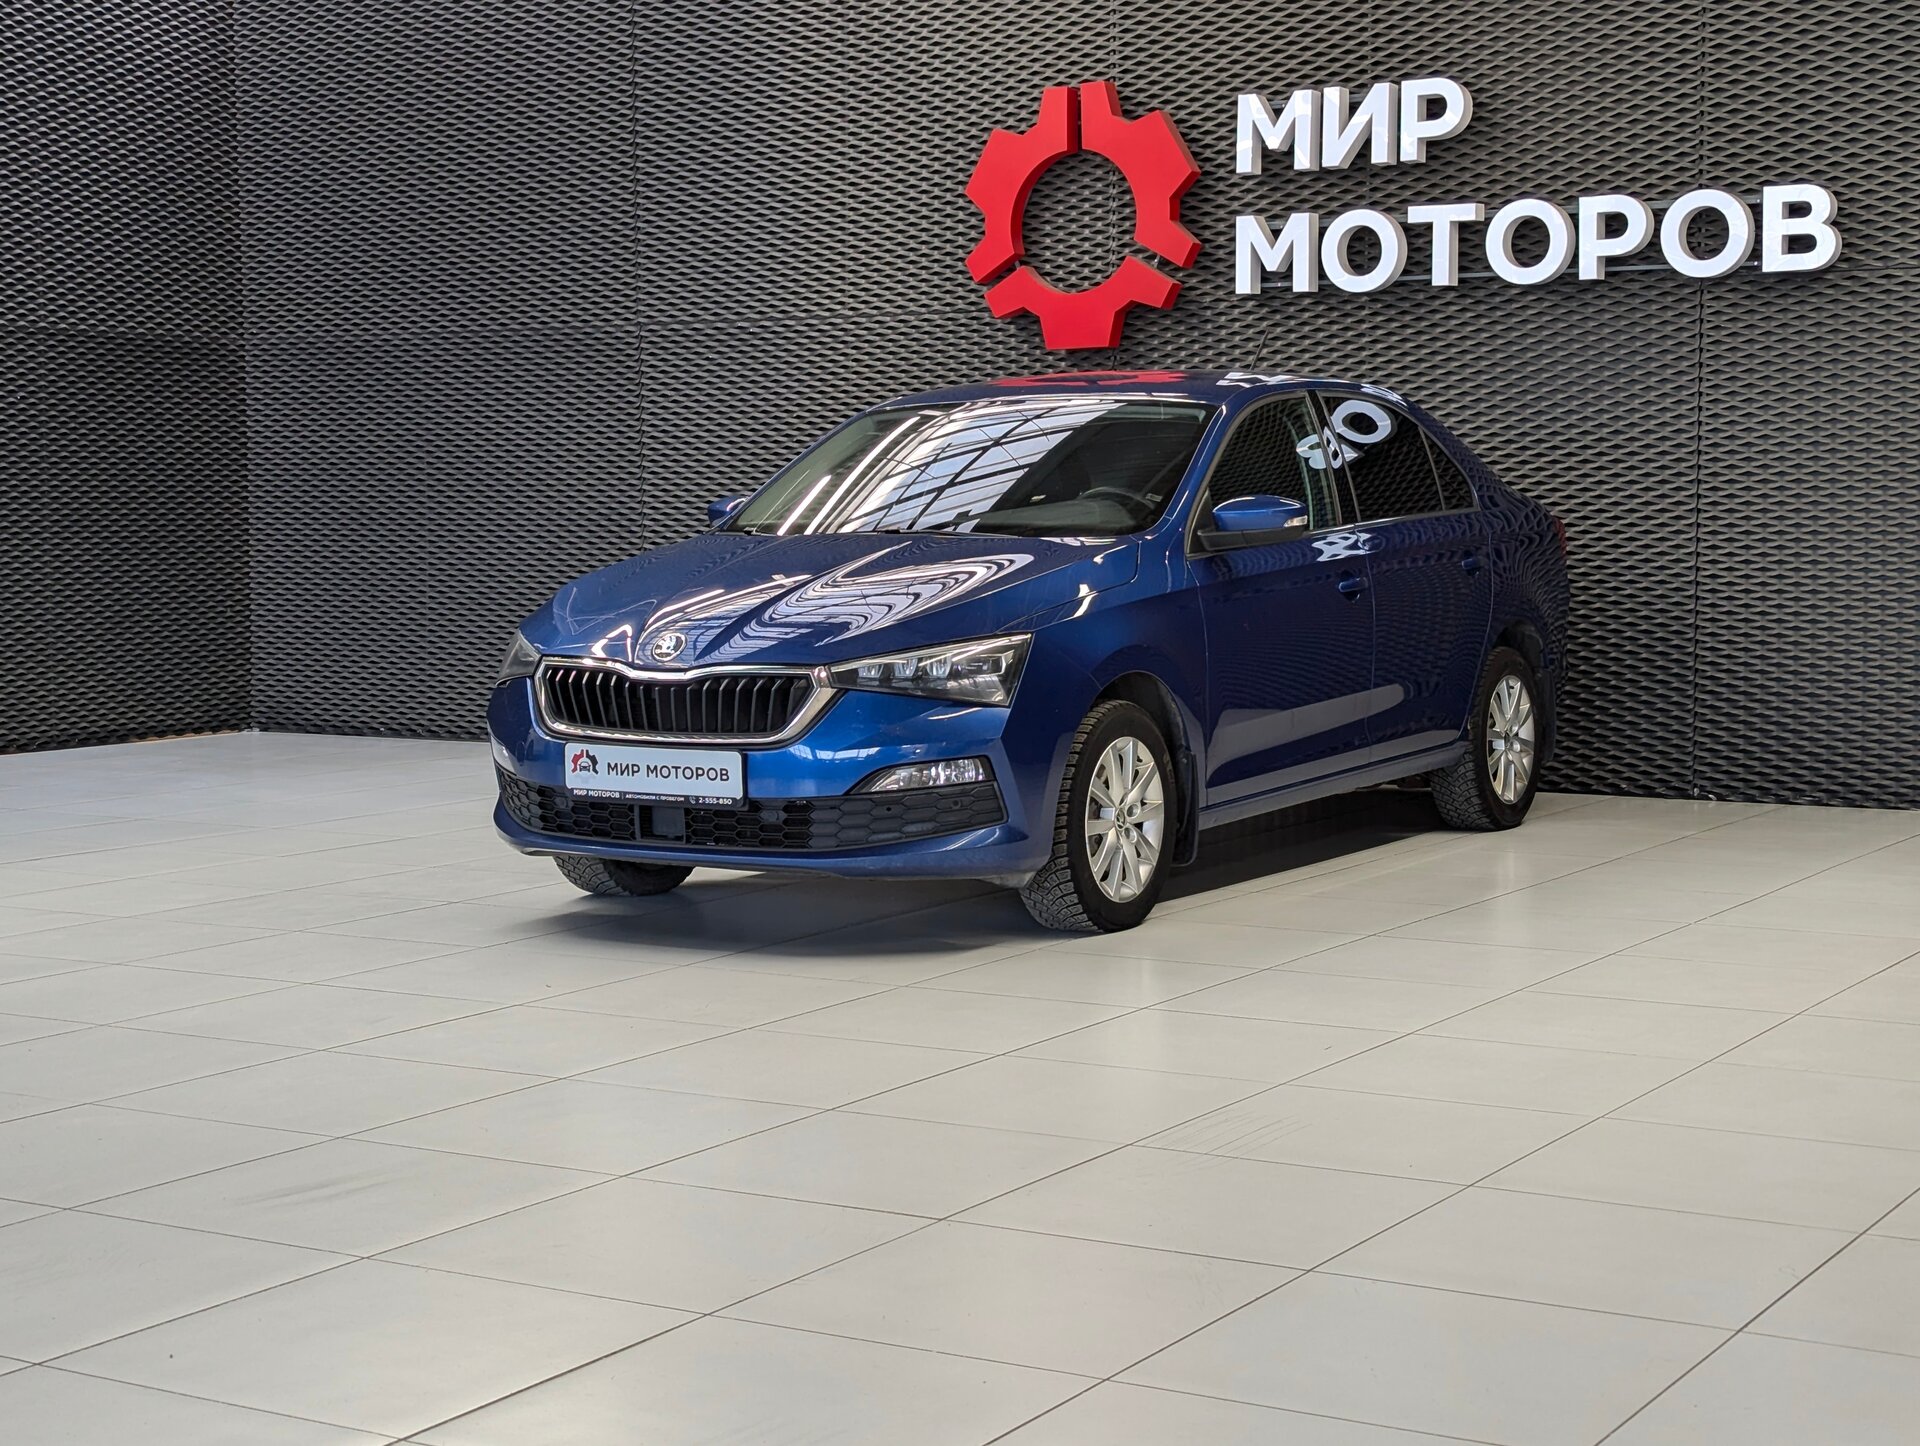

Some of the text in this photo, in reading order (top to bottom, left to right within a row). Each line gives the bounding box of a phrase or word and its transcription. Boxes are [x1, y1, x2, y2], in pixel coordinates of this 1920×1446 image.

[1235, 77, 1472, 175] МИР
[1234, 184, 1842, 294] МОТОРОВ
[588, 790, 620, 798] МОТОРОВ
[698, 797, 733, 805] 2-555-850
[607, 762, 730, 781] МИР МОТОРОВ
